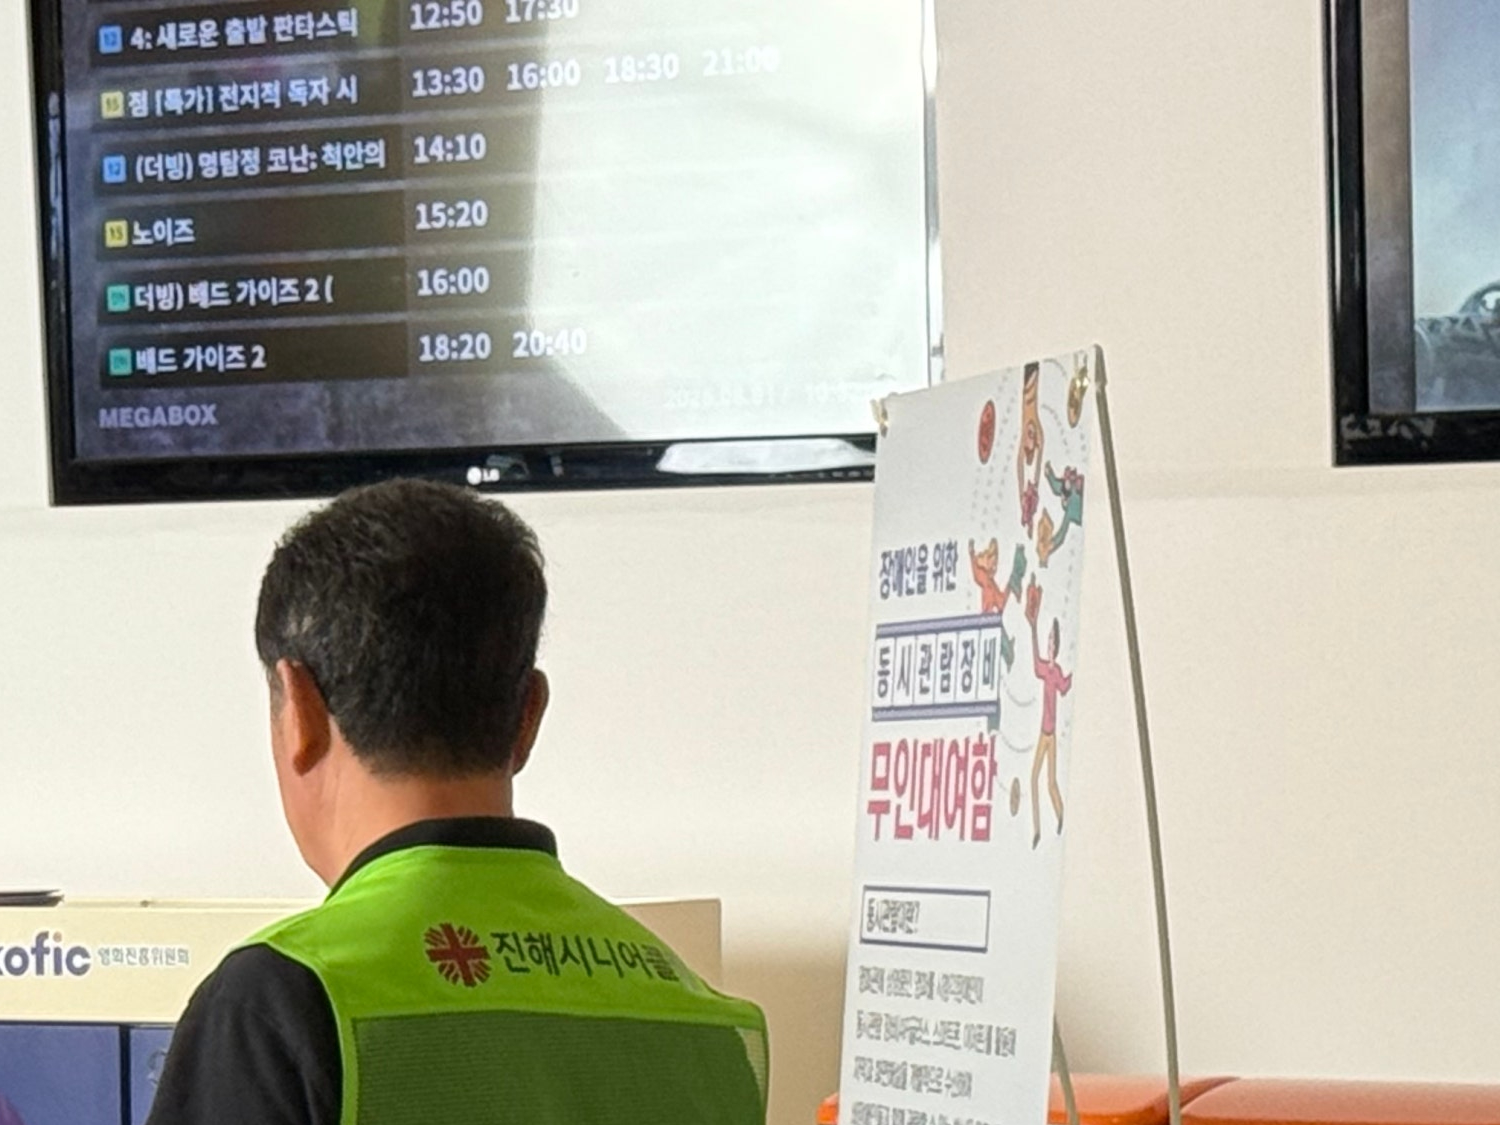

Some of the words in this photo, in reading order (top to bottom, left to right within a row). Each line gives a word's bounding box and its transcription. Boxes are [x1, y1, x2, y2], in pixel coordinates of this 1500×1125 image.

[130, 26, 152, 51] 4:
[156, 20, 221, 51] 새로운
[224, 16, 266, 45] 출발
[272, 9, 359, 42] 판타스틱
[410, 0, 483, 30] 12:50
[504, 0, 580, 23] 17:30
[218, 79, 282, 113] 전지적
[287, 77, 331, 106] 독자
[336, 75, 359, 104] 시
[411, 66, 485, 98] 13:30
[506, 60, 582, 91] 16:00
[603, 53, 680, 84] 18:30
[702, 46, 780, 77] 21:00
[135, 151, 194, 183] (더빙)
[197, 146, 262, 177] 명탐정
[266, 143, 319, 175] 코난:
[321, 138, 387, 169] 척안의
[412, 133, 487, 165] 14:10
[131, 217, 196, 248] 노이즈
[415, 199, 489, 230] 15:20
[134, 279, 184, 312] 더빙)
[188, 279, 232, 309] 배드
[236, 277, 300, 308] 가이즈
[305, 277, 320, 303] 2
[416, 266, 490, 297] 16:00
[136, 344, 179, 376] 배드
[182, 341, 247, 372] 가이즈
[251, 345, 267, 370] 2
[418, 331, 492, 362] 18:20
[512, 327, 588, 360] 20:40
[99, 403, 220, 430] MEGABOX
[878, 545, 930, 602] 장애인을
[931, 538, 960, 595] 위한
[876, 630, 998, 700] 동시관람장비
[867, 732, 998, 842] 무인대여함
[97, 945, 191, 968] 영화진흥위원회
